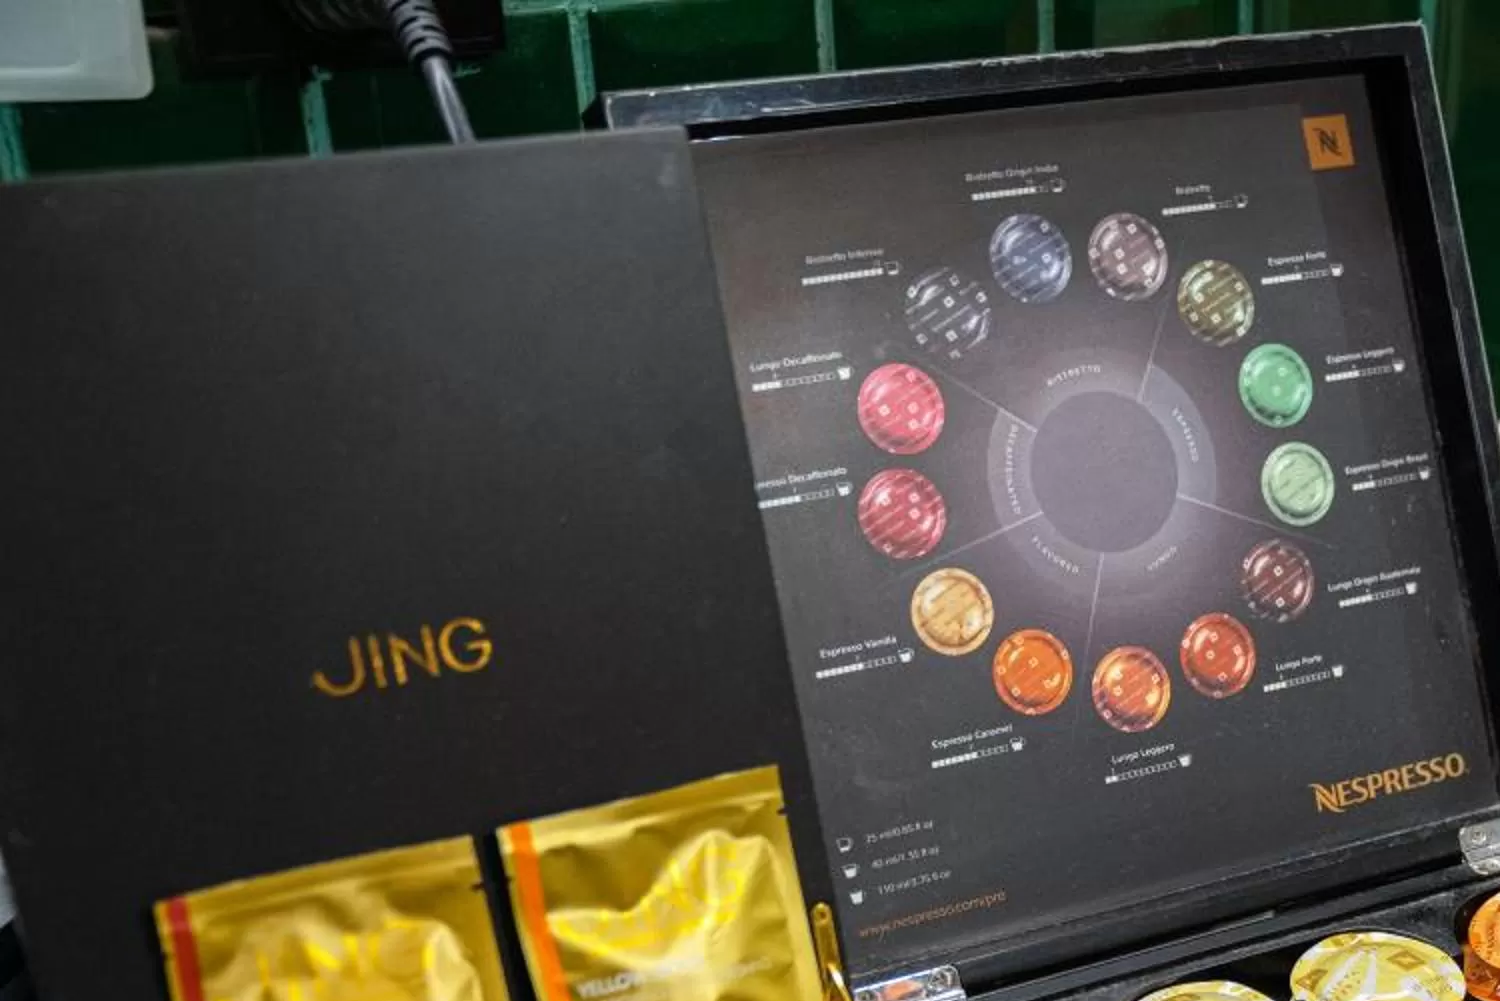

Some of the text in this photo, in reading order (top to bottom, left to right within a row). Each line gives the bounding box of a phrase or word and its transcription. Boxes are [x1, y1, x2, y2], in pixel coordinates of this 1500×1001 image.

[311, 616, 494, 697] JING
[819, 642, 863, 659] Espresso
[1309, 752, 1466, 814] NESPRESSO
